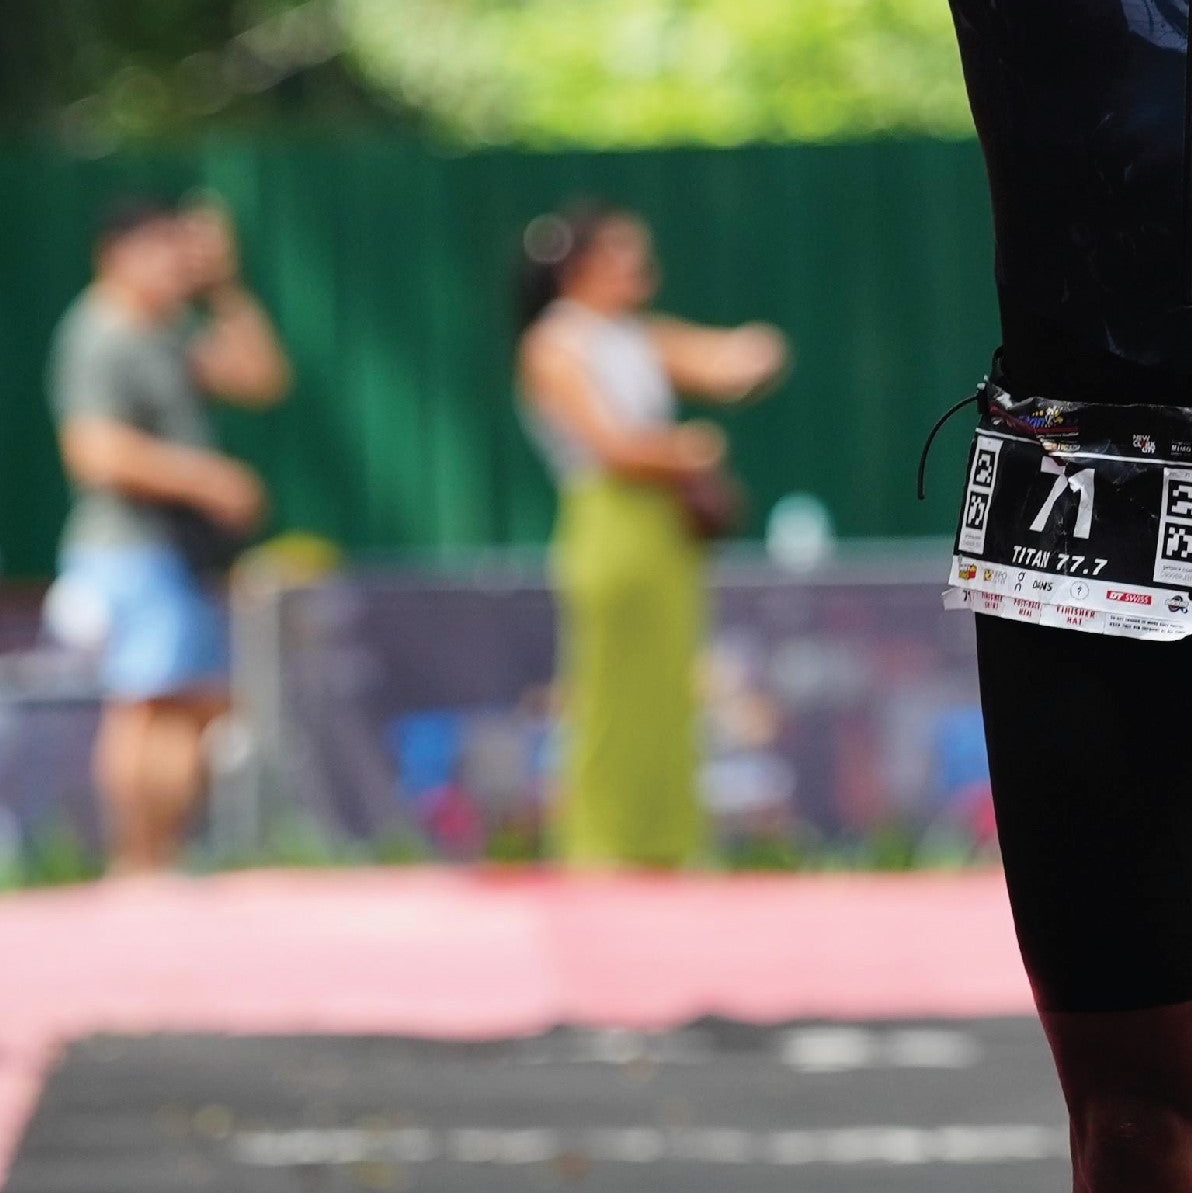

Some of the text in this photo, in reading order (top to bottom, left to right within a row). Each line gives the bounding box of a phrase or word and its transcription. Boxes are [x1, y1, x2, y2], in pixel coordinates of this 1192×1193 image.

[1029, 456, 1095, 539] 71
[1011, 545, 1108, 576] TITAN 77.7
[1108, 591, 1150, 605] DT SWISS
[1056, 604, 1096, 619] FINISHER
